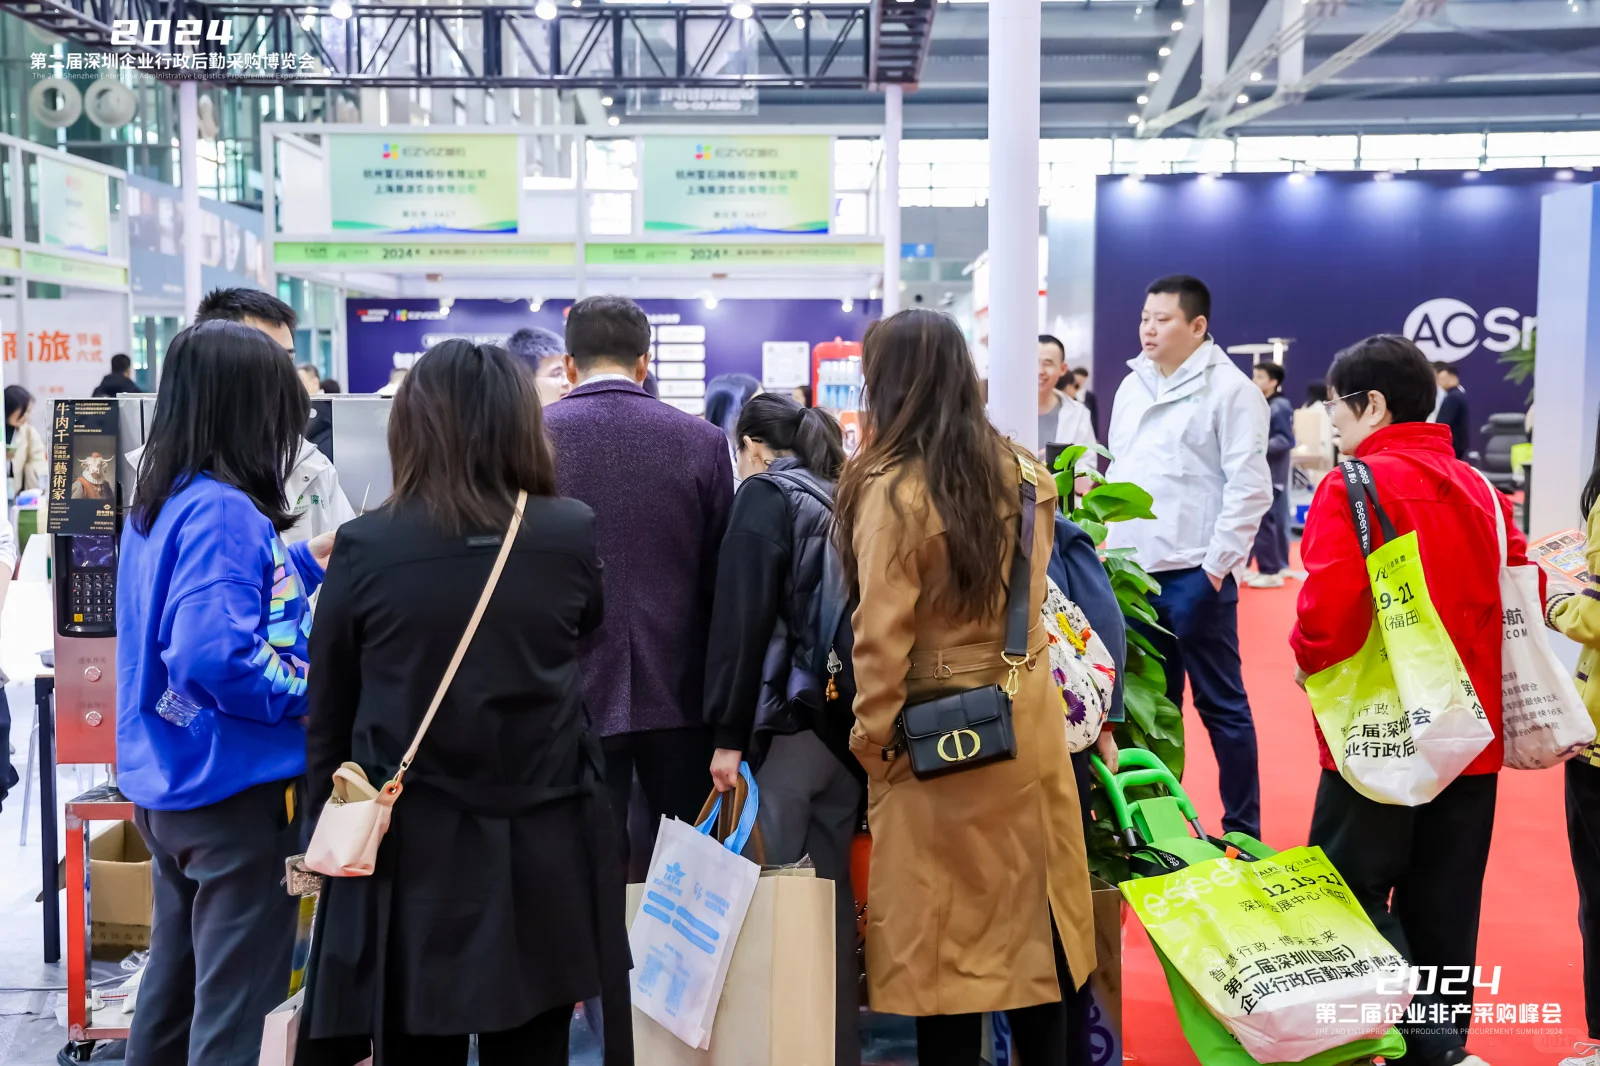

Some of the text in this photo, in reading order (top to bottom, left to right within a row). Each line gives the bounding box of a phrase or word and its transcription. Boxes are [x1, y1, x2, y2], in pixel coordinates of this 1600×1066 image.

[54, 402, 70, 443] 牛肉干
[1355, 501, 1367, 534] eseen
